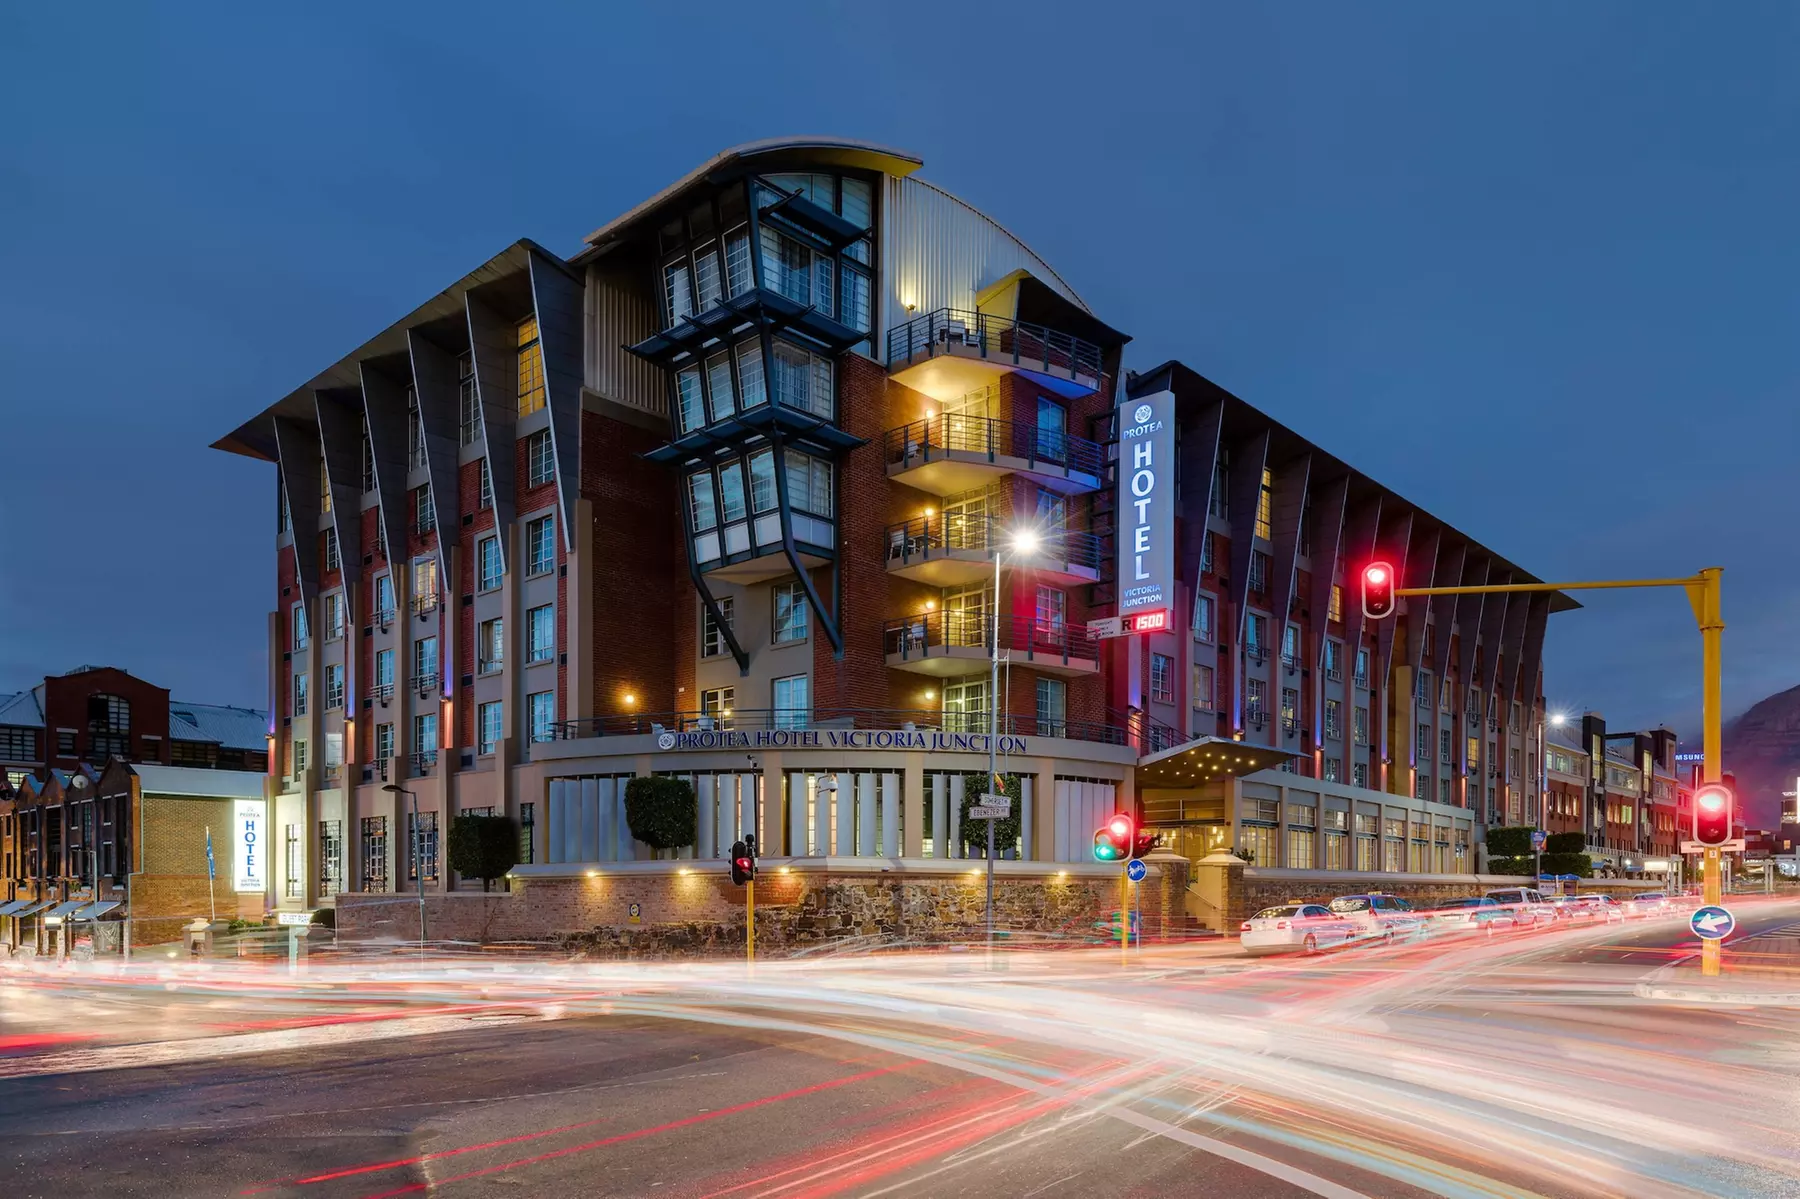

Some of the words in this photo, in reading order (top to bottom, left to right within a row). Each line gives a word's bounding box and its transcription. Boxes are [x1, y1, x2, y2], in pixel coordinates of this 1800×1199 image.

[1123, 420, 1163, 440] PROTEA
[1131, 440, 1155, 580] HOTEL
[1123, 584, 1161, 597] VICTORIA
[1122, 593, 1162, 608] JUNCTION
[1121, 619, 1132, 631] R
[1136, 614, 1164, 630] 1500
[677, 731, 751, 749] PROTEA
[757, 731, 822, 748] HOTEL
[828, 731, 926, 749] VICTORIA
[931, 733, 1028, 753] JUNCTON
[973, 808, 1000, 816] EBENEZER
[244, 820, 256, 877] HOTEL
